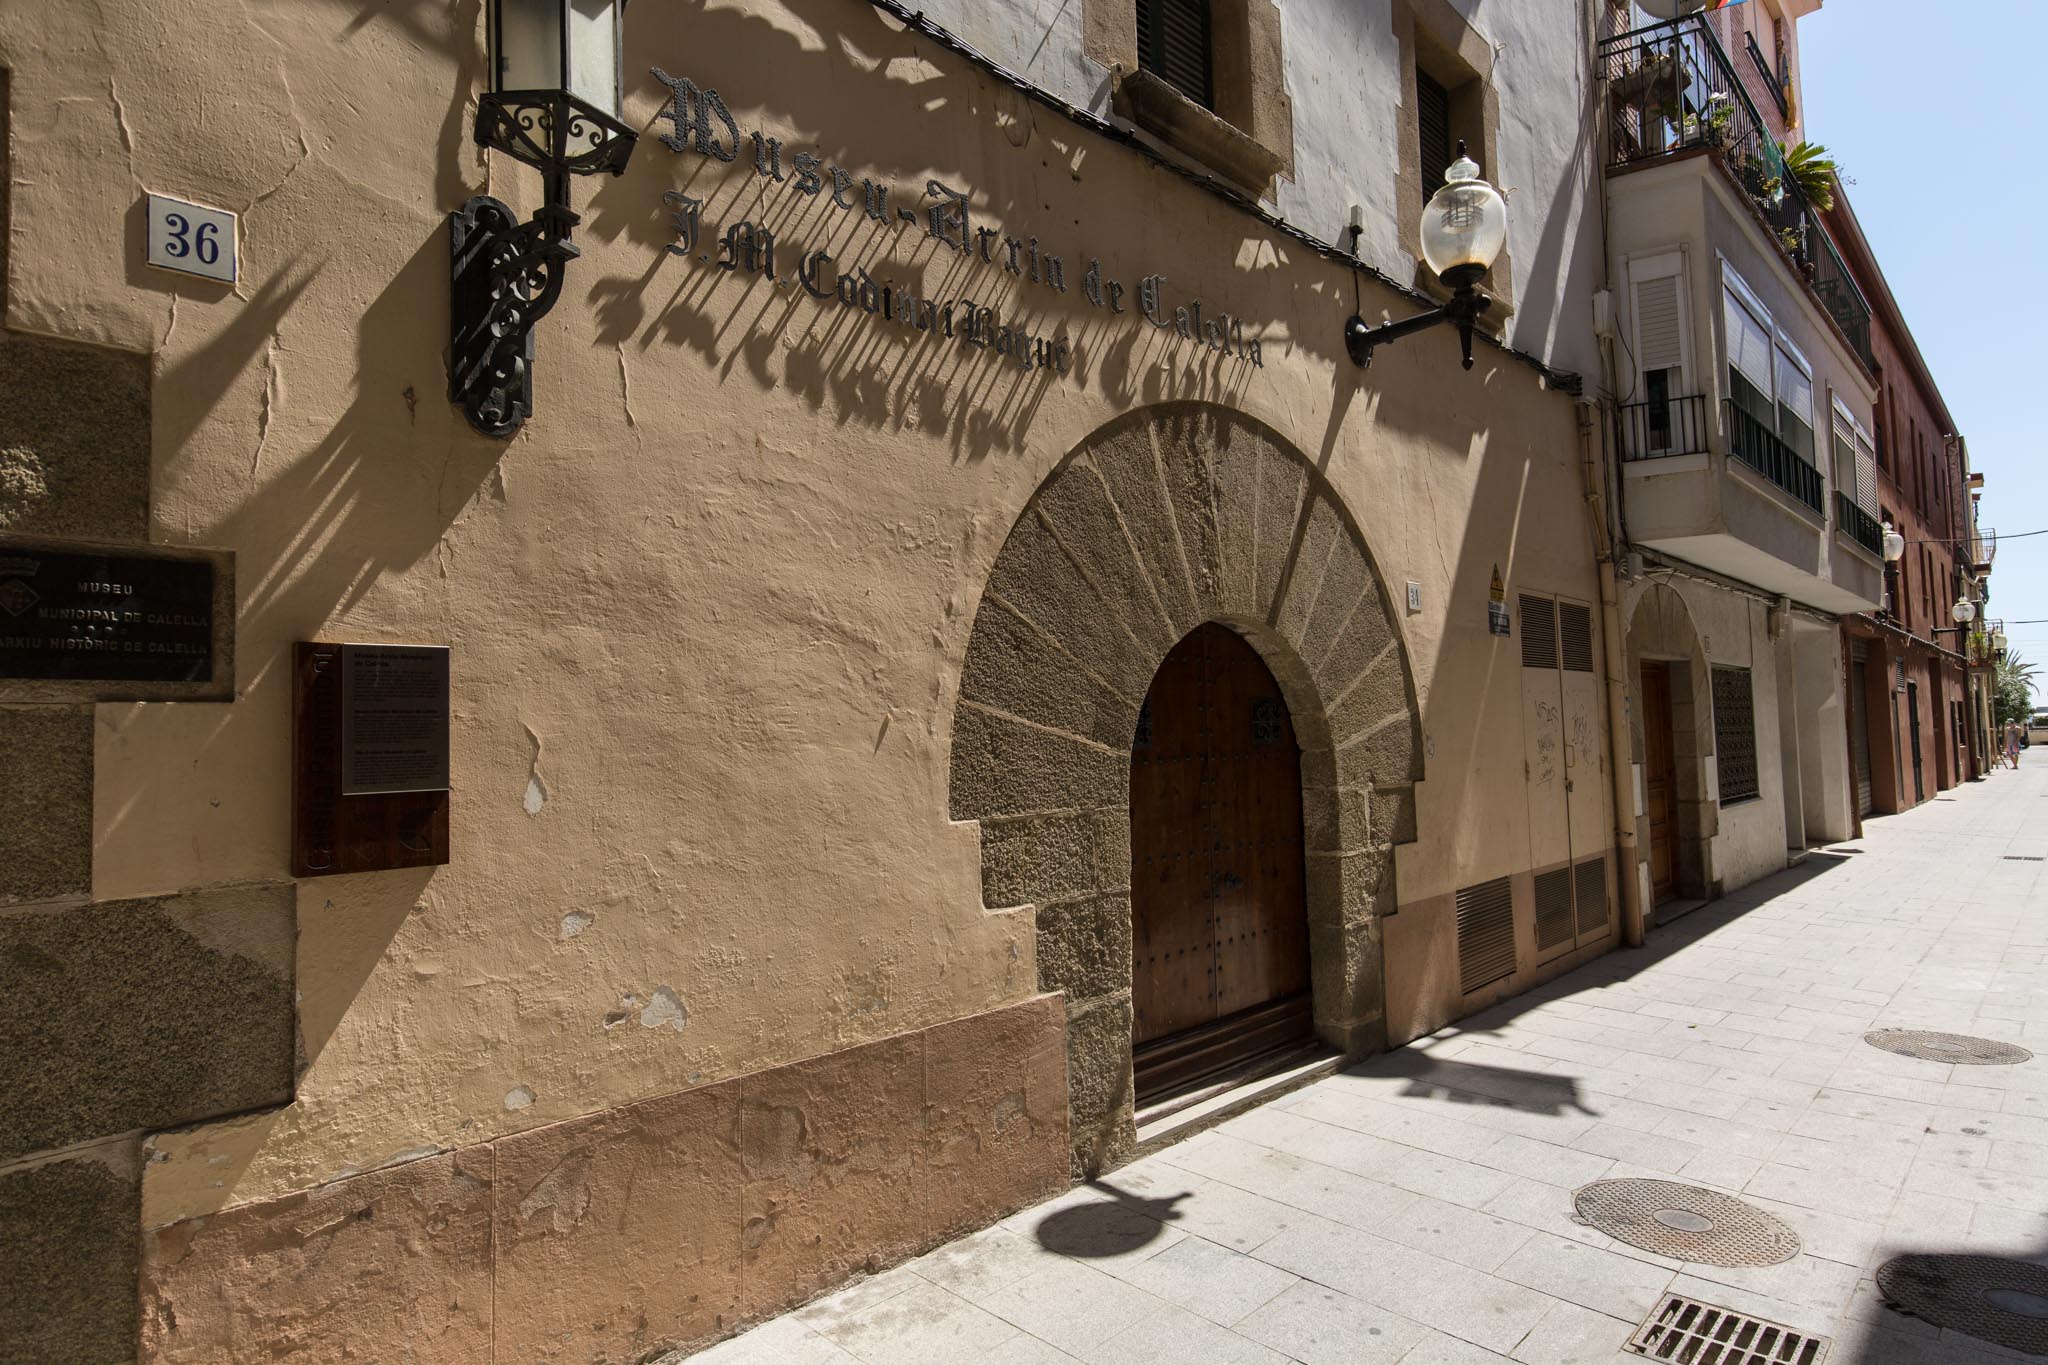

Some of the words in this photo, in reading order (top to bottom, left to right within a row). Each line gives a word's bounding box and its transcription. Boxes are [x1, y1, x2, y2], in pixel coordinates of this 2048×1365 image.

[165, 213, 219, 265] 36
[798, 250, 938, 336] Codina
[960, 299, 1070, 374] Bagué
[1084, 257, 1125, 314] de
[1137, 273, 1264, 369] Calella
[78, 582, 133, 595] MUSEU
[39, 607, 119, 621] MUNICIPAL
[124, 611, 142, 623] DE
[147, 614, 208, 627] CALELLA
[49, 636, 118, 650] HISTÒRIC
[124, 641, 142, 652] DE
[148, 641, 208, 655] CALELLA
